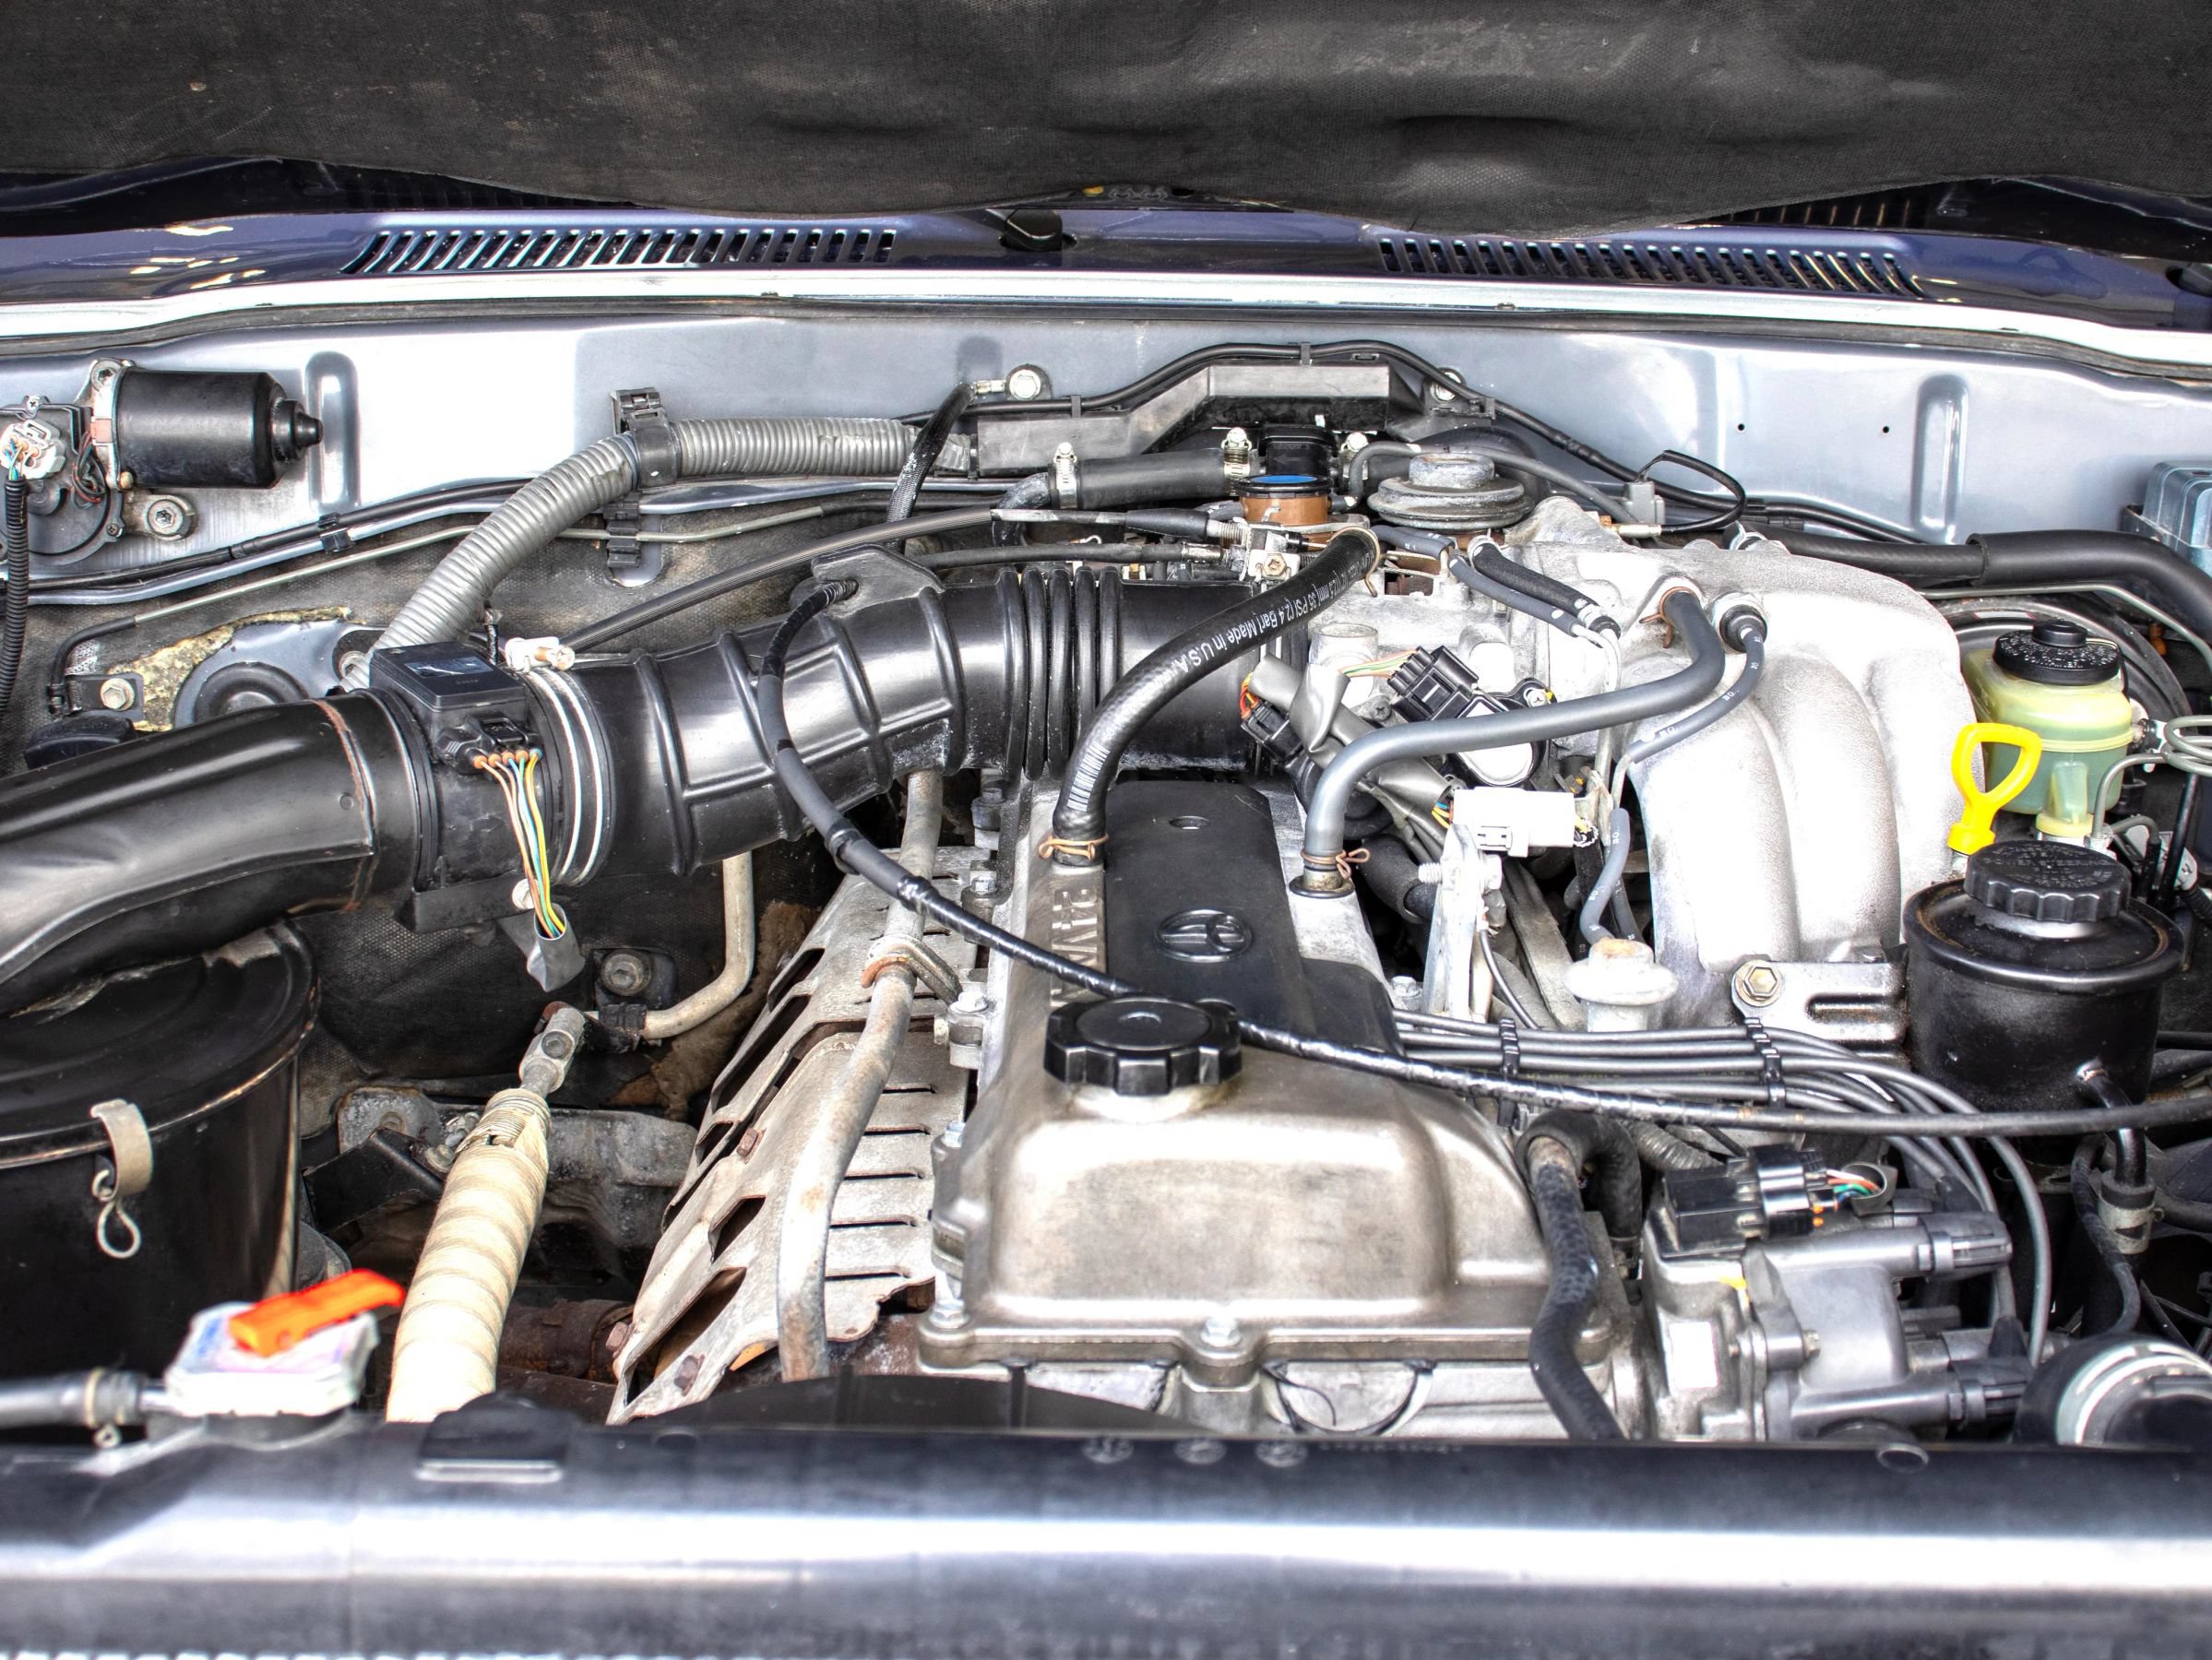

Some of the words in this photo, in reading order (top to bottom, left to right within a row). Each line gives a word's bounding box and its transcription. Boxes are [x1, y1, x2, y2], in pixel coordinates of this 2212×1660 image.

[1293, 599, 1309, 617] PSI
[1306, 591, 1318, 610] 35
[1226, 618, 1258, 644] Made
[1213, 632, 1228, 652] in
